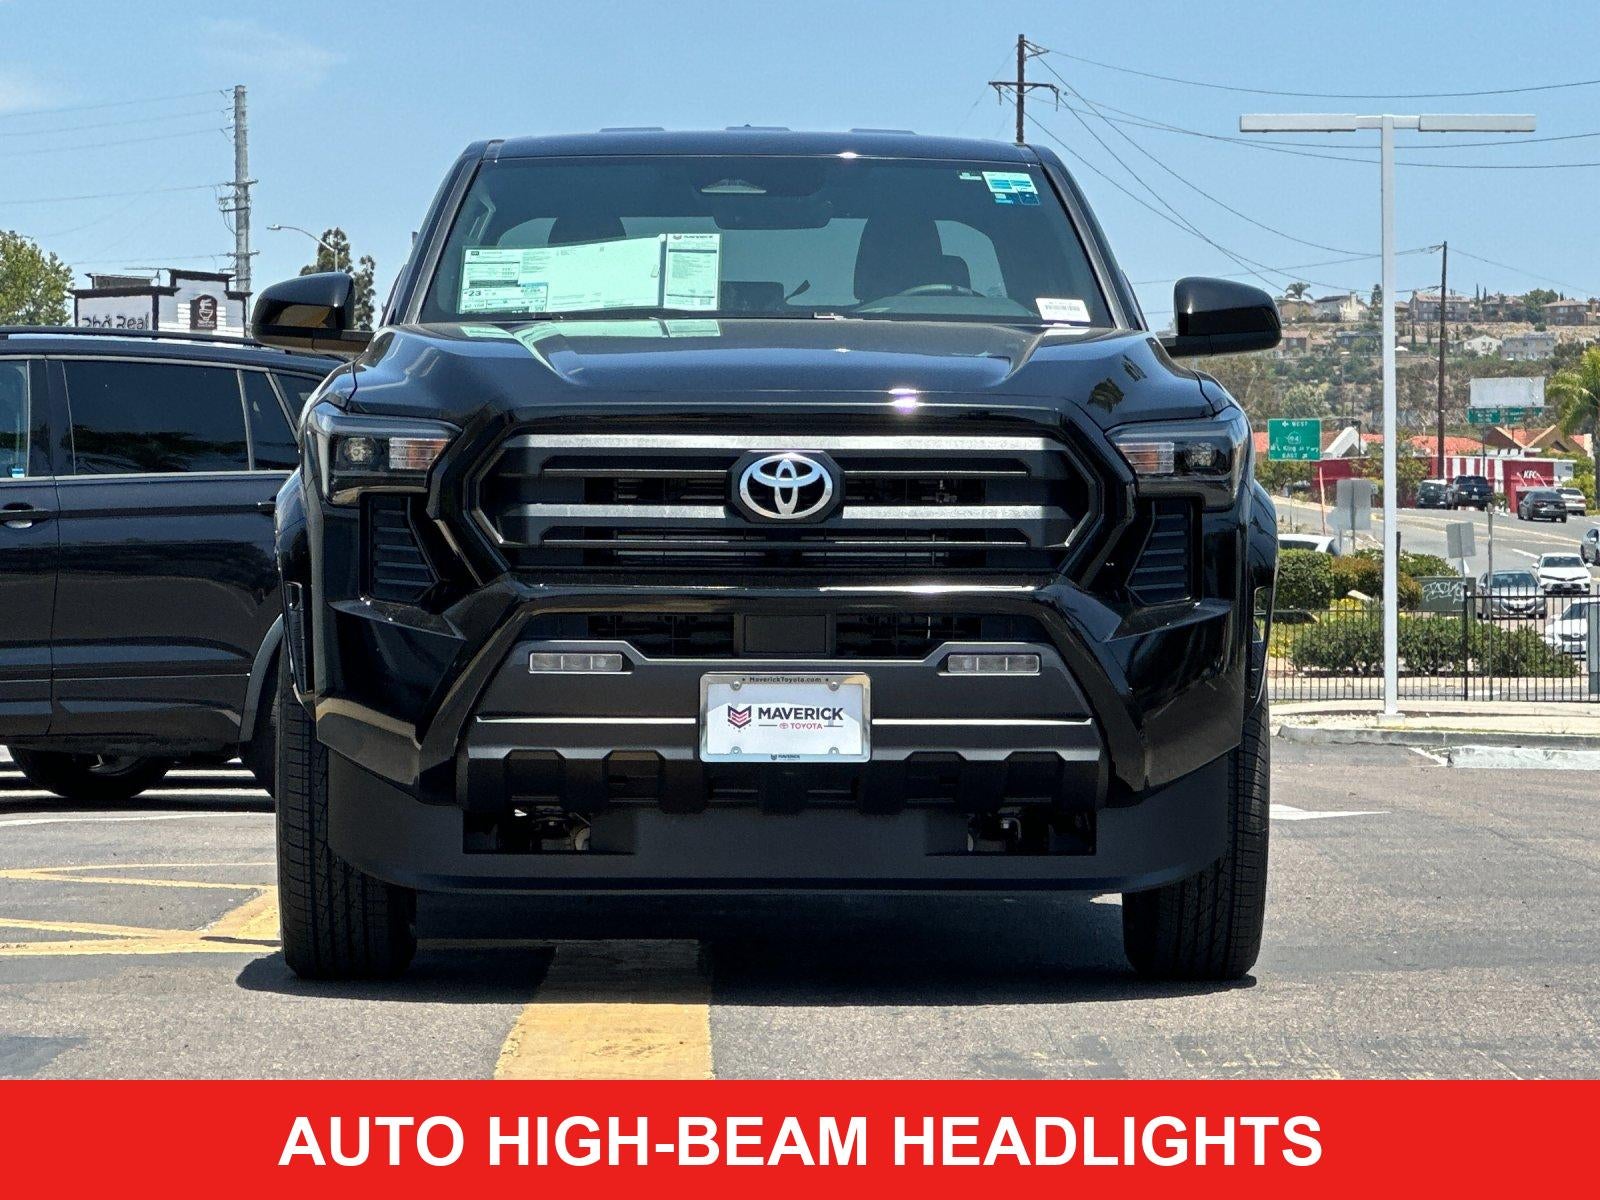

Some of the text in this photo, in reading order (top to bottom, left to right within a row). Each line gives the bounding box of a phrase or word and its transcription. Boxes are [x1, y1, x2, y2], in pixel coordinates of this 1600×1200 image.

[1523, 470, 1538, 479] KFC
[749, 676, 822, 684] MaverickToyota.com
[758, 707, 844, 721] MAVERICK
[790, 722, 823, 730] TOYOTA
